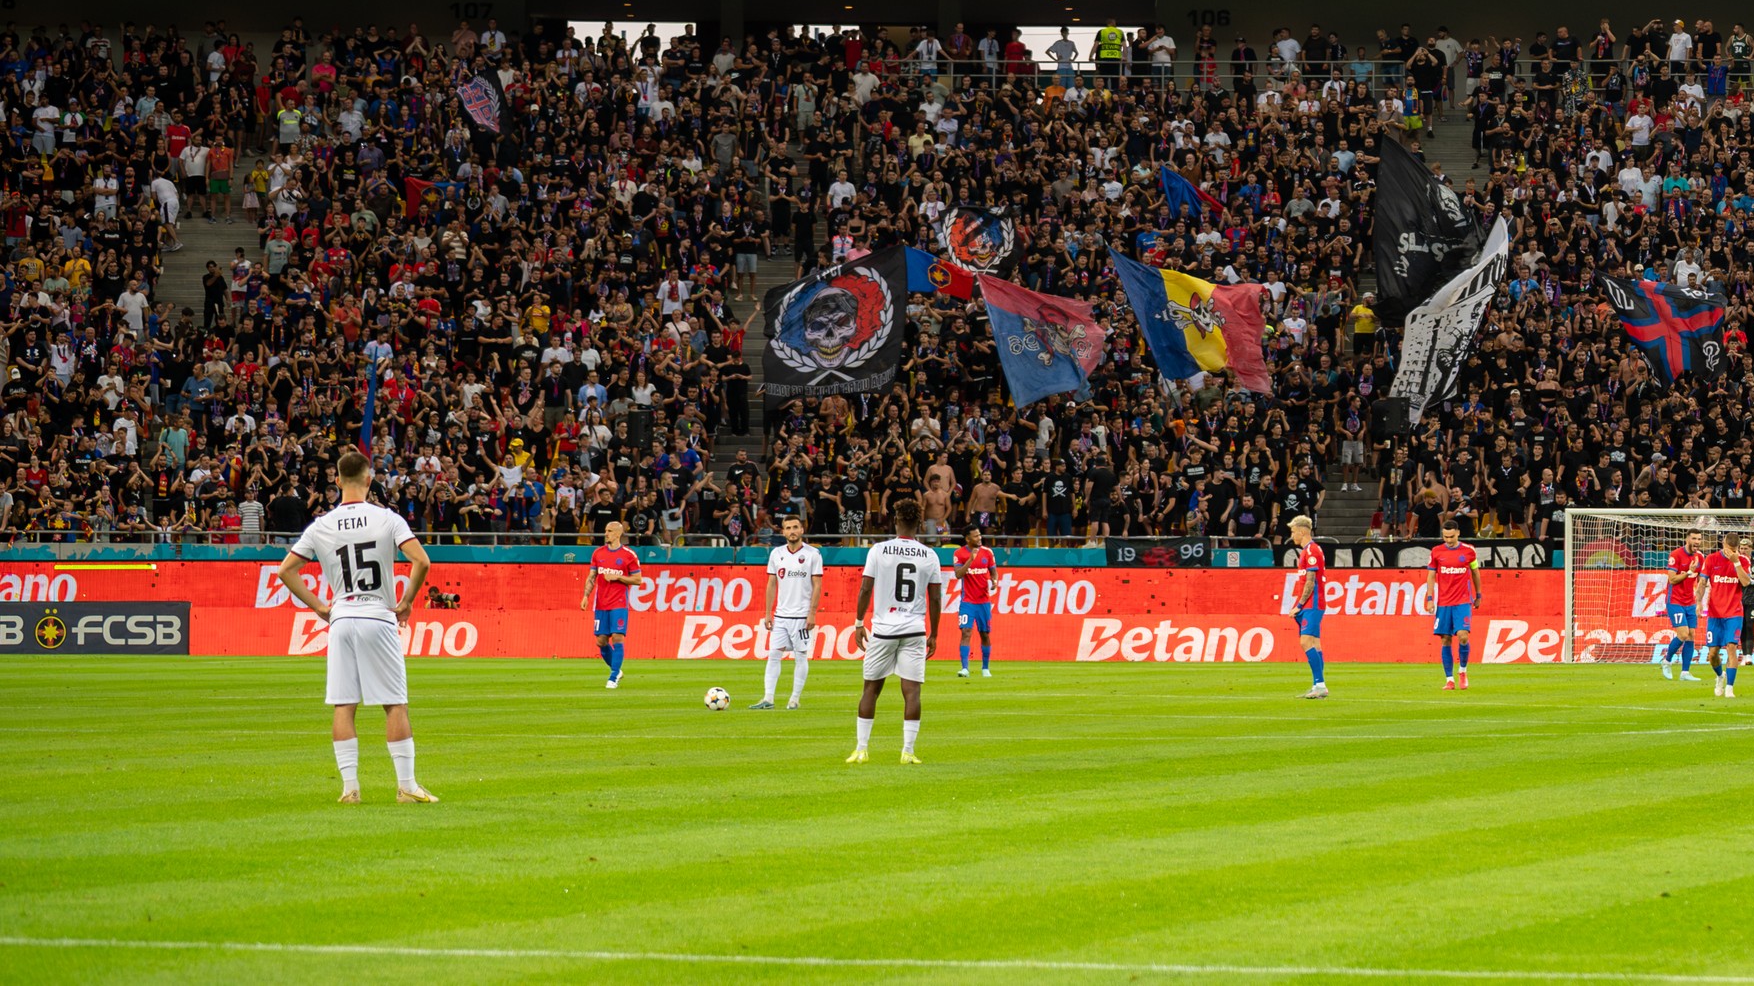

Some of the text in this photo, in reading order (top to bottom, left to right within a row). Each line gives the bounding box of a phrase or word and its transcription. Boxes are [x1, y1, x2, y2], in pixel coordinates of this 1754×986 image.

[449, 2, 493, 19] 107
[1187, 9, 1231, 26] 106
[337, 515, 369, 531] FETAI
[882, 545, 928, 559] ALHASSAN
[1116, 543, 1205, 562] 19 96
[335, 541, 382, 593] 15
[787, 569, 808, 579] Ecolog
[1440, 565, 1467, 575] Betano
[895, 563, 916, 603] 6
[1713, 574, 1739, 584] Betan
[628, 569, 753, 614] etano
[1673, 612, 1684, 625] 17
[72, 614, 182, 646] FCSB
[798, 628, 810, 640] 10
[1705, 630, 1713, 644] 9
[1076, 618, 1275, 663] Betano
